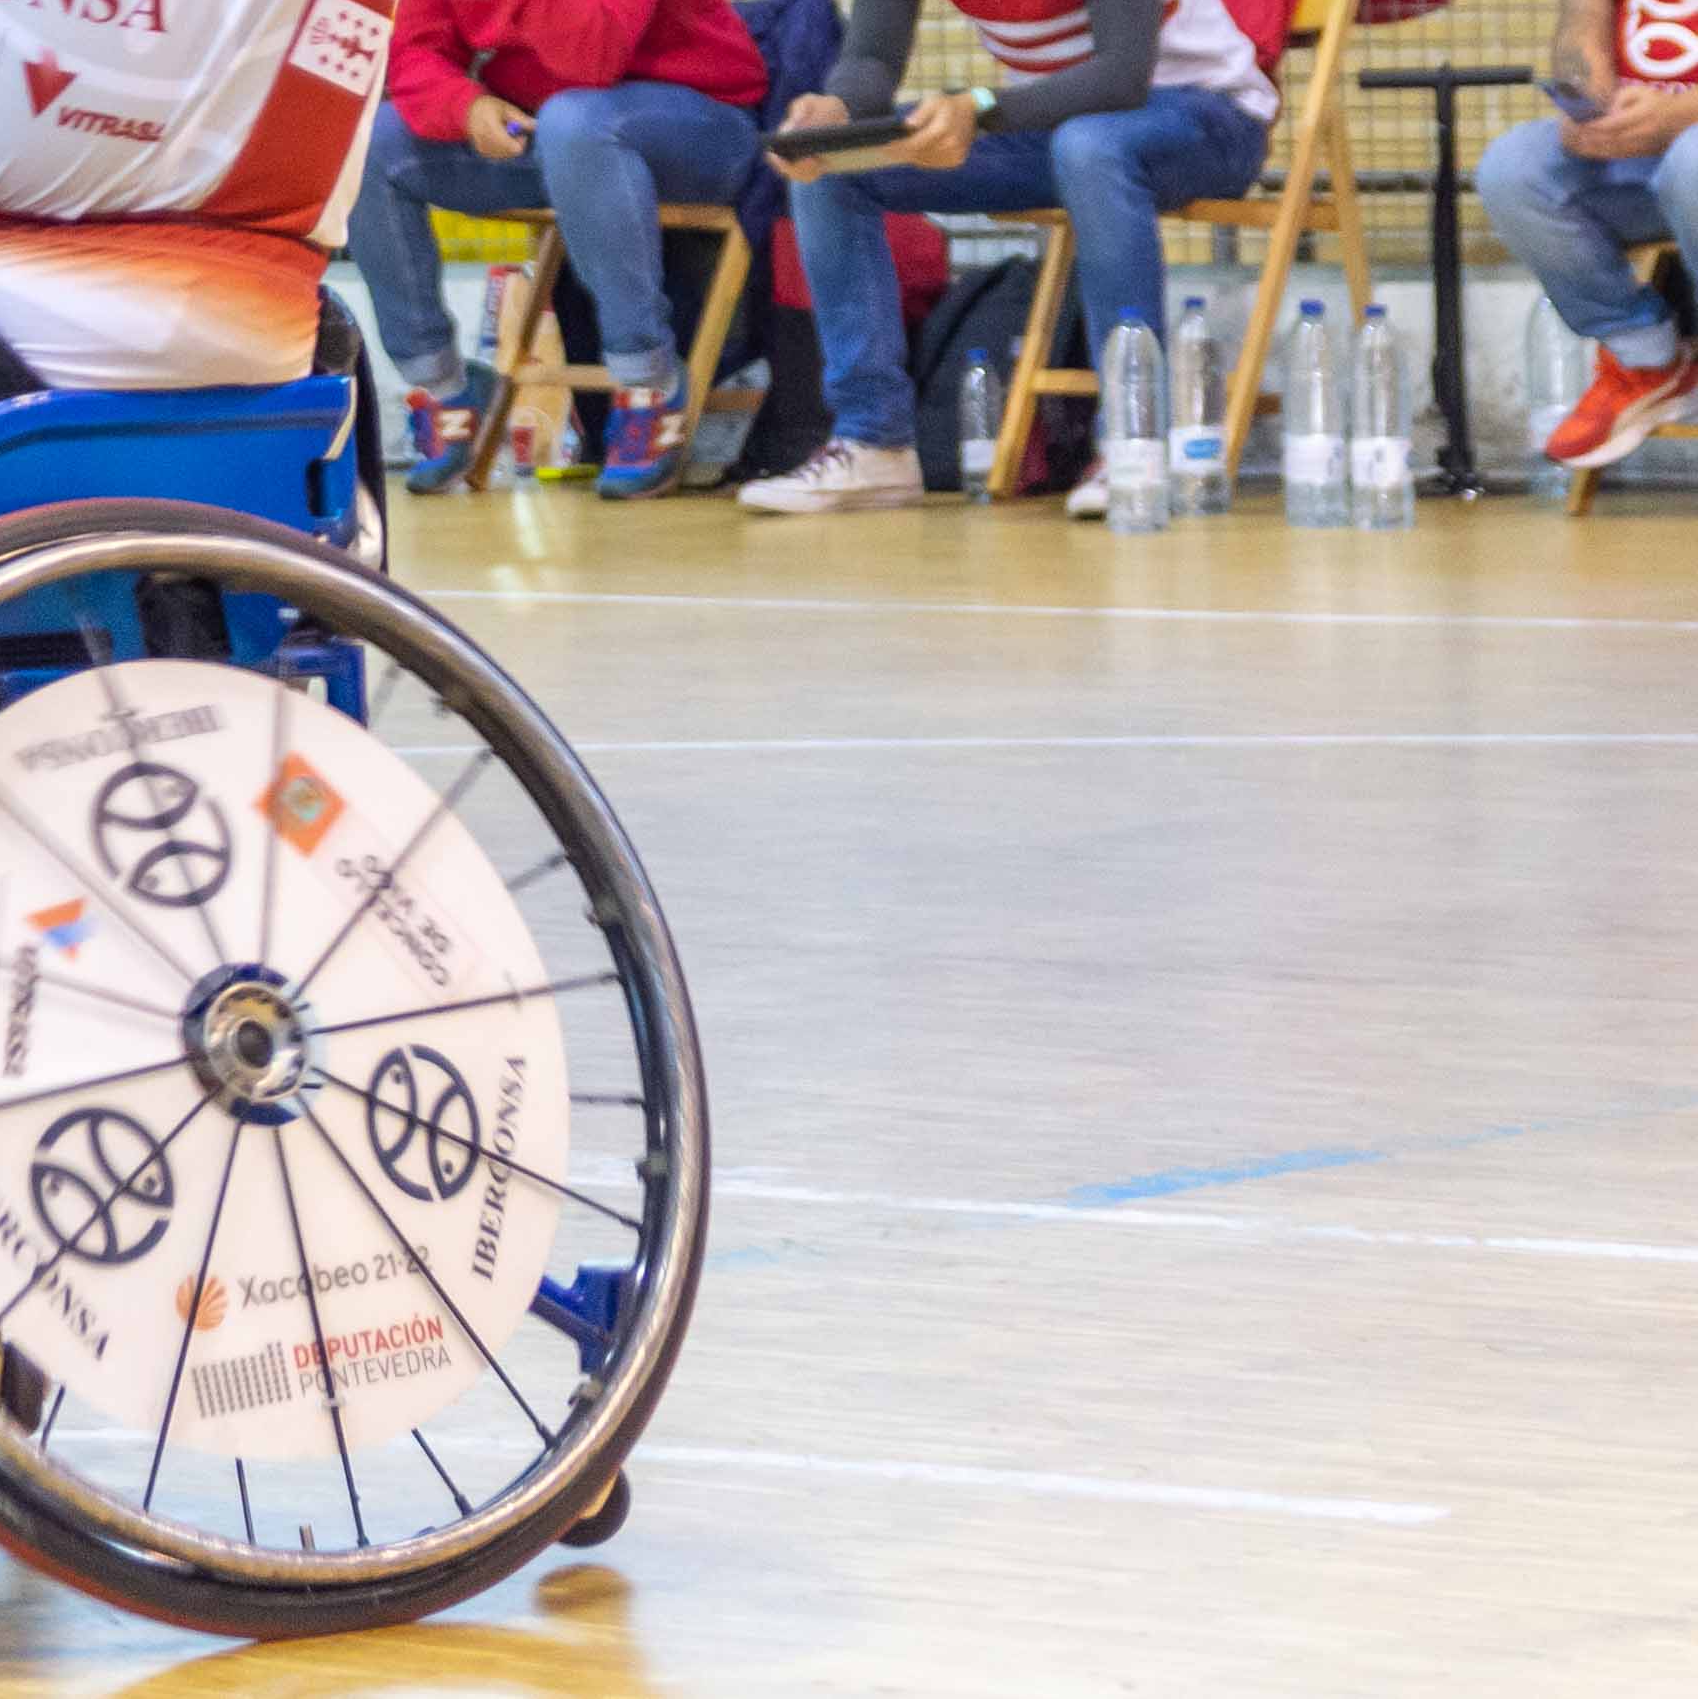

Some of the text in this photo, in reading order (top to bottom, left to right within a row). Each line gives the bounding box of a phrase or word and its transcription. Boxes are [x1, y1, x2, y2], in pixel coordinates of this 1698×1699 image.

[472, 1055, 528, 1284] IBERCONSA
[293, 1312, 445, 1370] DEPUTACIÓN
[299, 1345, 453, 1398] PONTEVEDRA
